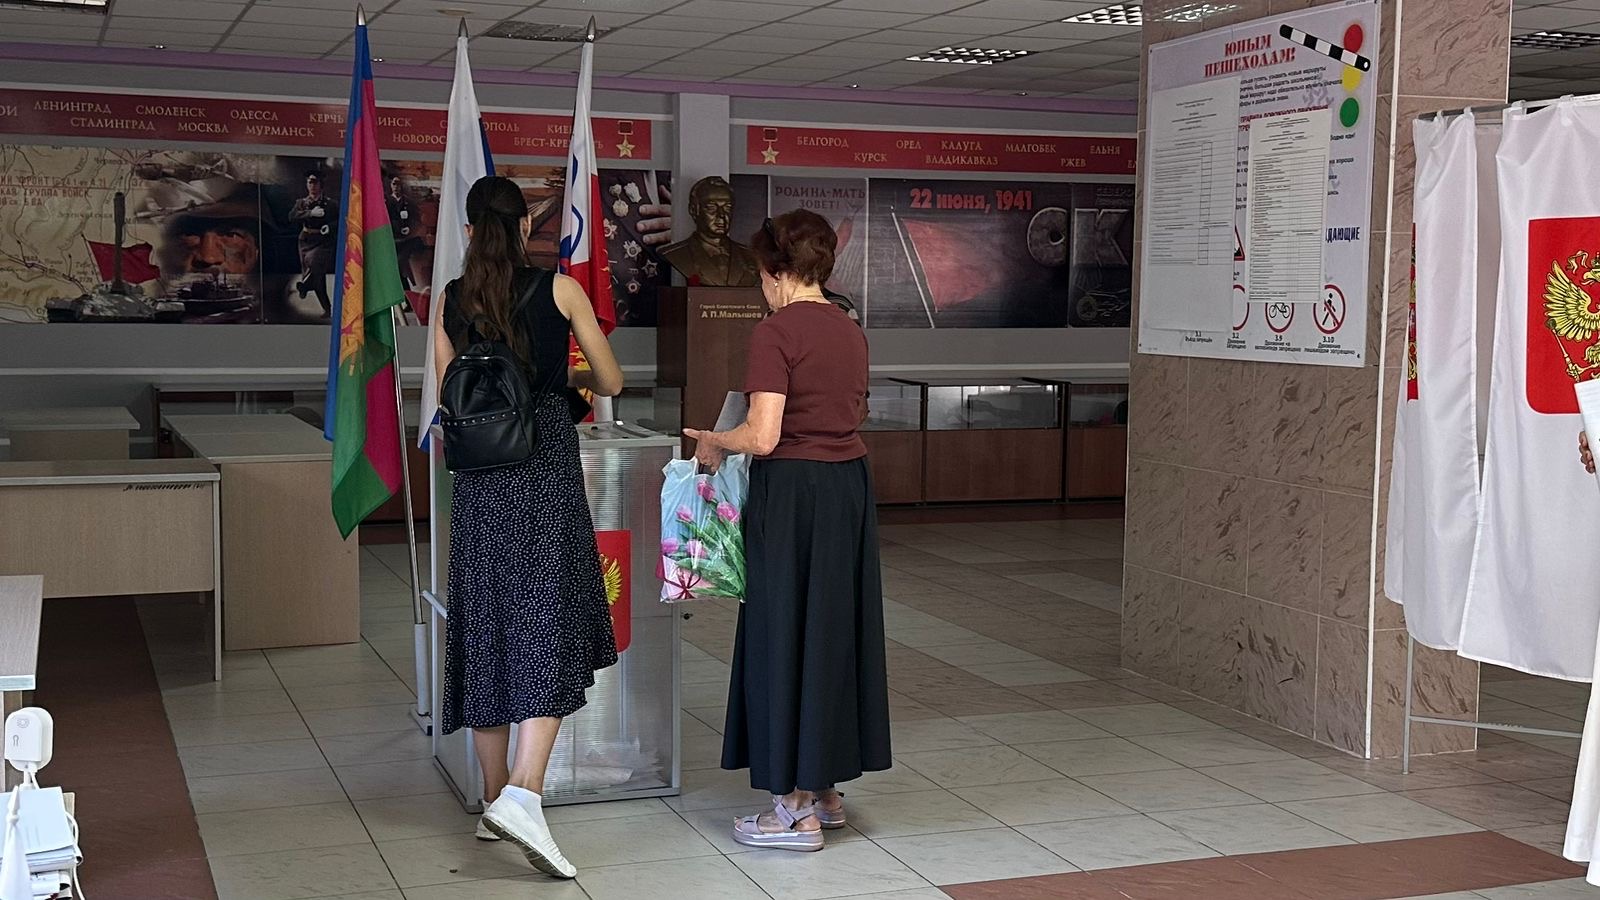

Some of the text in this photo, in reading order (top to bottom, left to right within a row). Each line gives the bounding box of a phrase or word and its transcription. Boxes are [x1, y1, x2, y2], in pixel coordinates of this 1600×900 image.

[1225, 34, 1271, 57] ЮНЫМ
[1204, 47, 1296, 78] ПЕШЕХОДАМ!
[34, 100, 112, 114] ЛЕНИНГРАД
[136, 104, 207, 118] СМОЛЕНСК
[230, 109, 279, 121] ОДЕССА
[309, 112, 344, 124] КЕРЧЬ
[70, 117, 156, 131] СТАЛИНГРАД
[178, 122, 229, 134] МОСКВА
[246, 125, 315, 138] МУРМАНСК
[797, 136, 1121, 156] БЕЛГОРОД ОРЕЛ КАЛУГА МАЛГОБЕК ЕЛЬНЯ
[854, 152, 888, 163] КУРСК
[926, 154, 999, 166] ВЛАДИКАВКАЗ
[1061, 158, 1087, 168] РЖЕВ
[775, 186, 866, 199] РОДИНА-МАТЬ
[910, 188, 1033, 213] 22 июня, 1941
[1326, 226, 1360, 243] ДАЮЩИЕ
